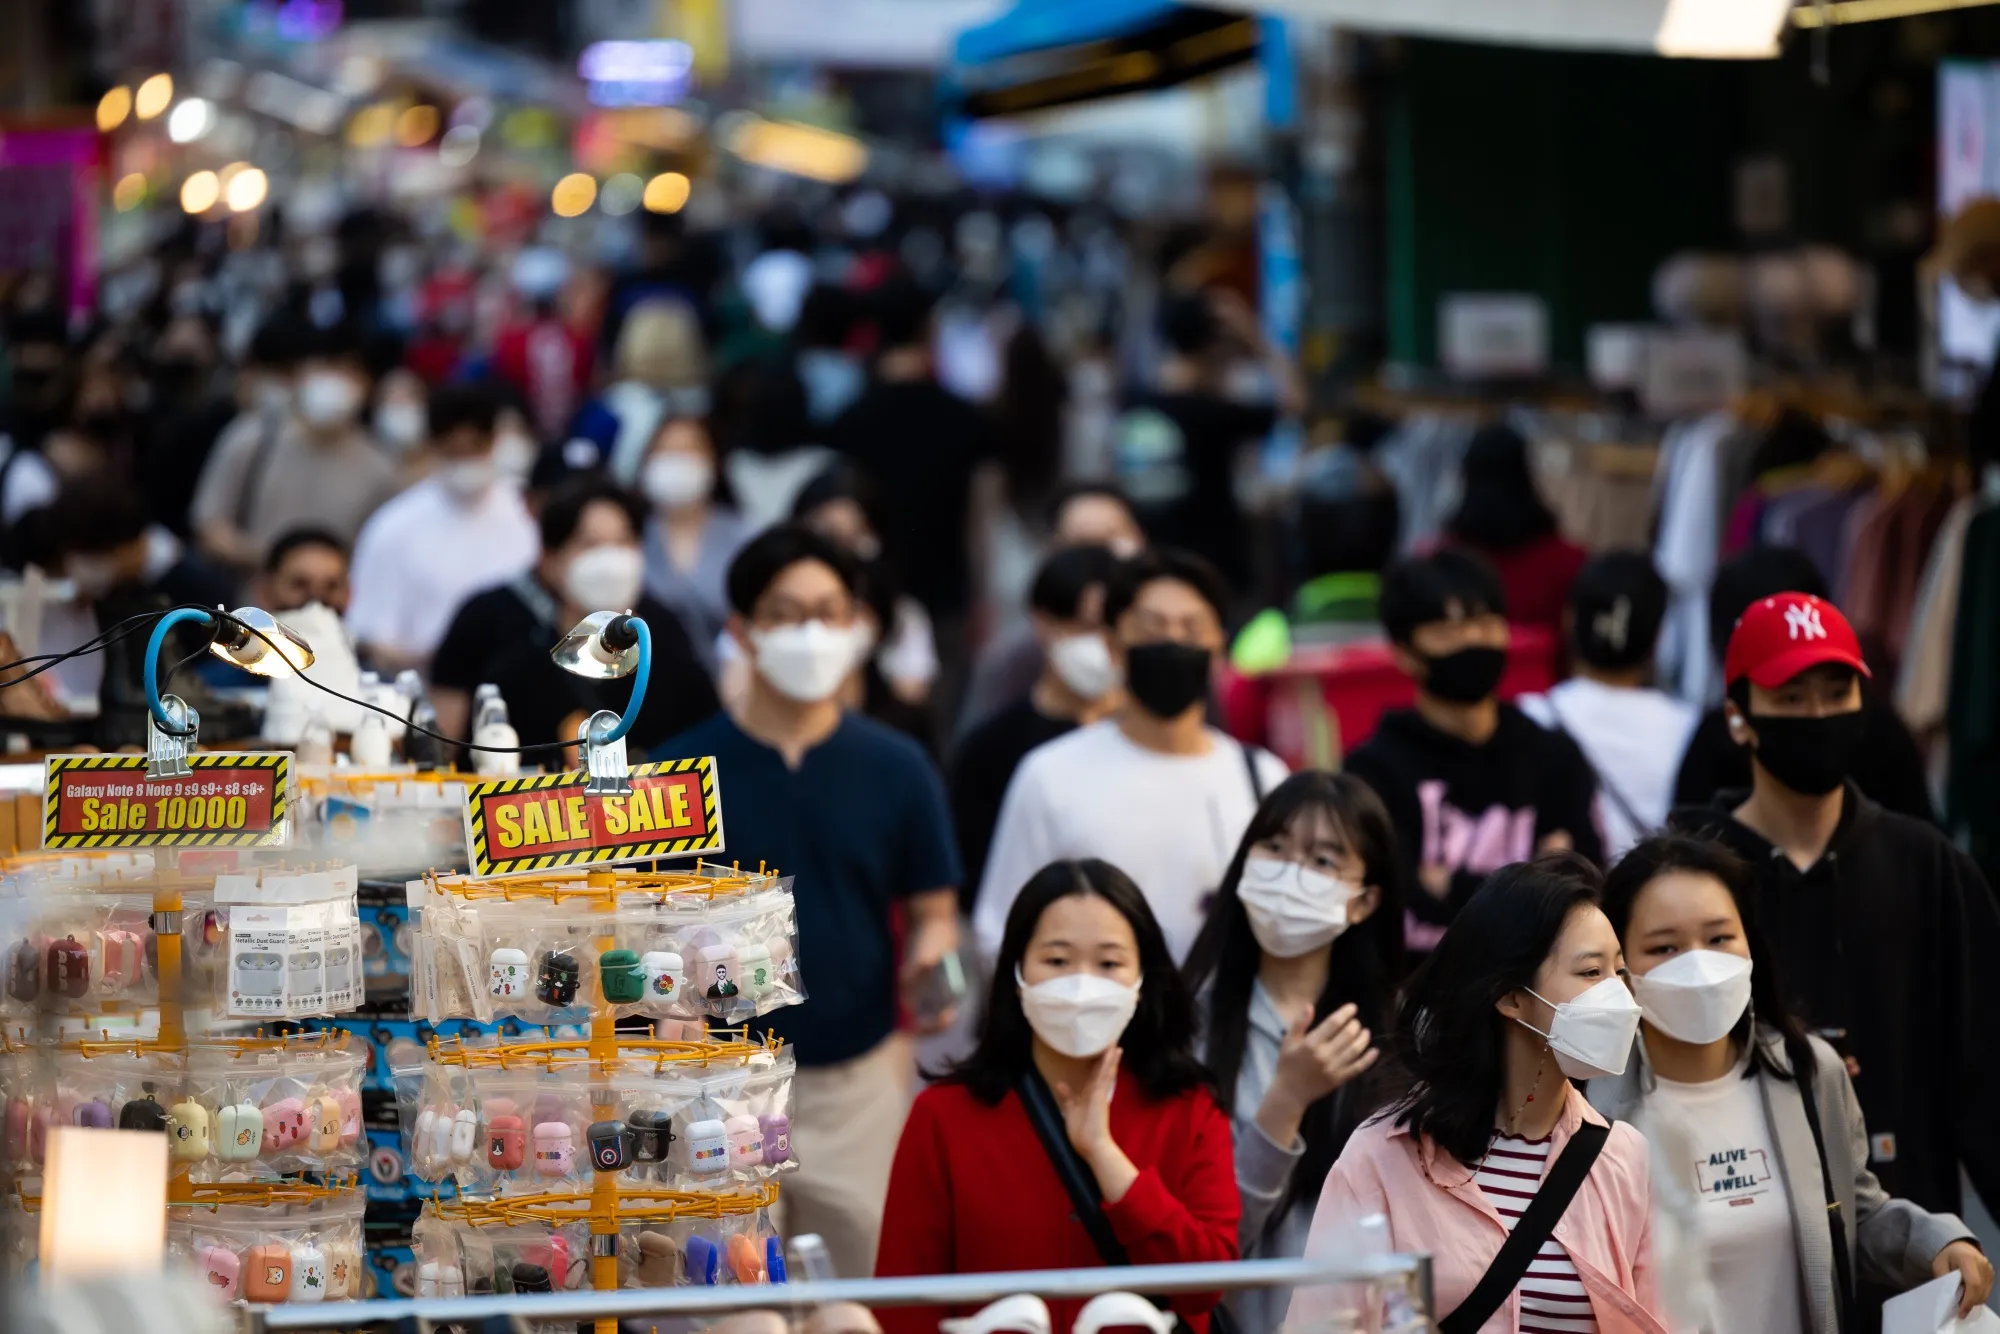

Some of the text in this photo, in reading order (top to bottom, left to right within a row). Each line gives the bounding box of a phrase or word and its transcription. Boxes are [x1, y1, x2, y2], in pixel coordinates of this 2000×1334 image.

[1783, 601, 1827, 641] NY
[66, 782, 265, 799] Galaxy Note 8 Note 9 s9 s9+ s8 s8+
[81, 797, 247, 831] Sale 10000
[495, 783, 692, 849] SALE SALE
[1709, 1149, 1747, 1166] ALIVE
[1727, 1165, 1735, 1176] &
